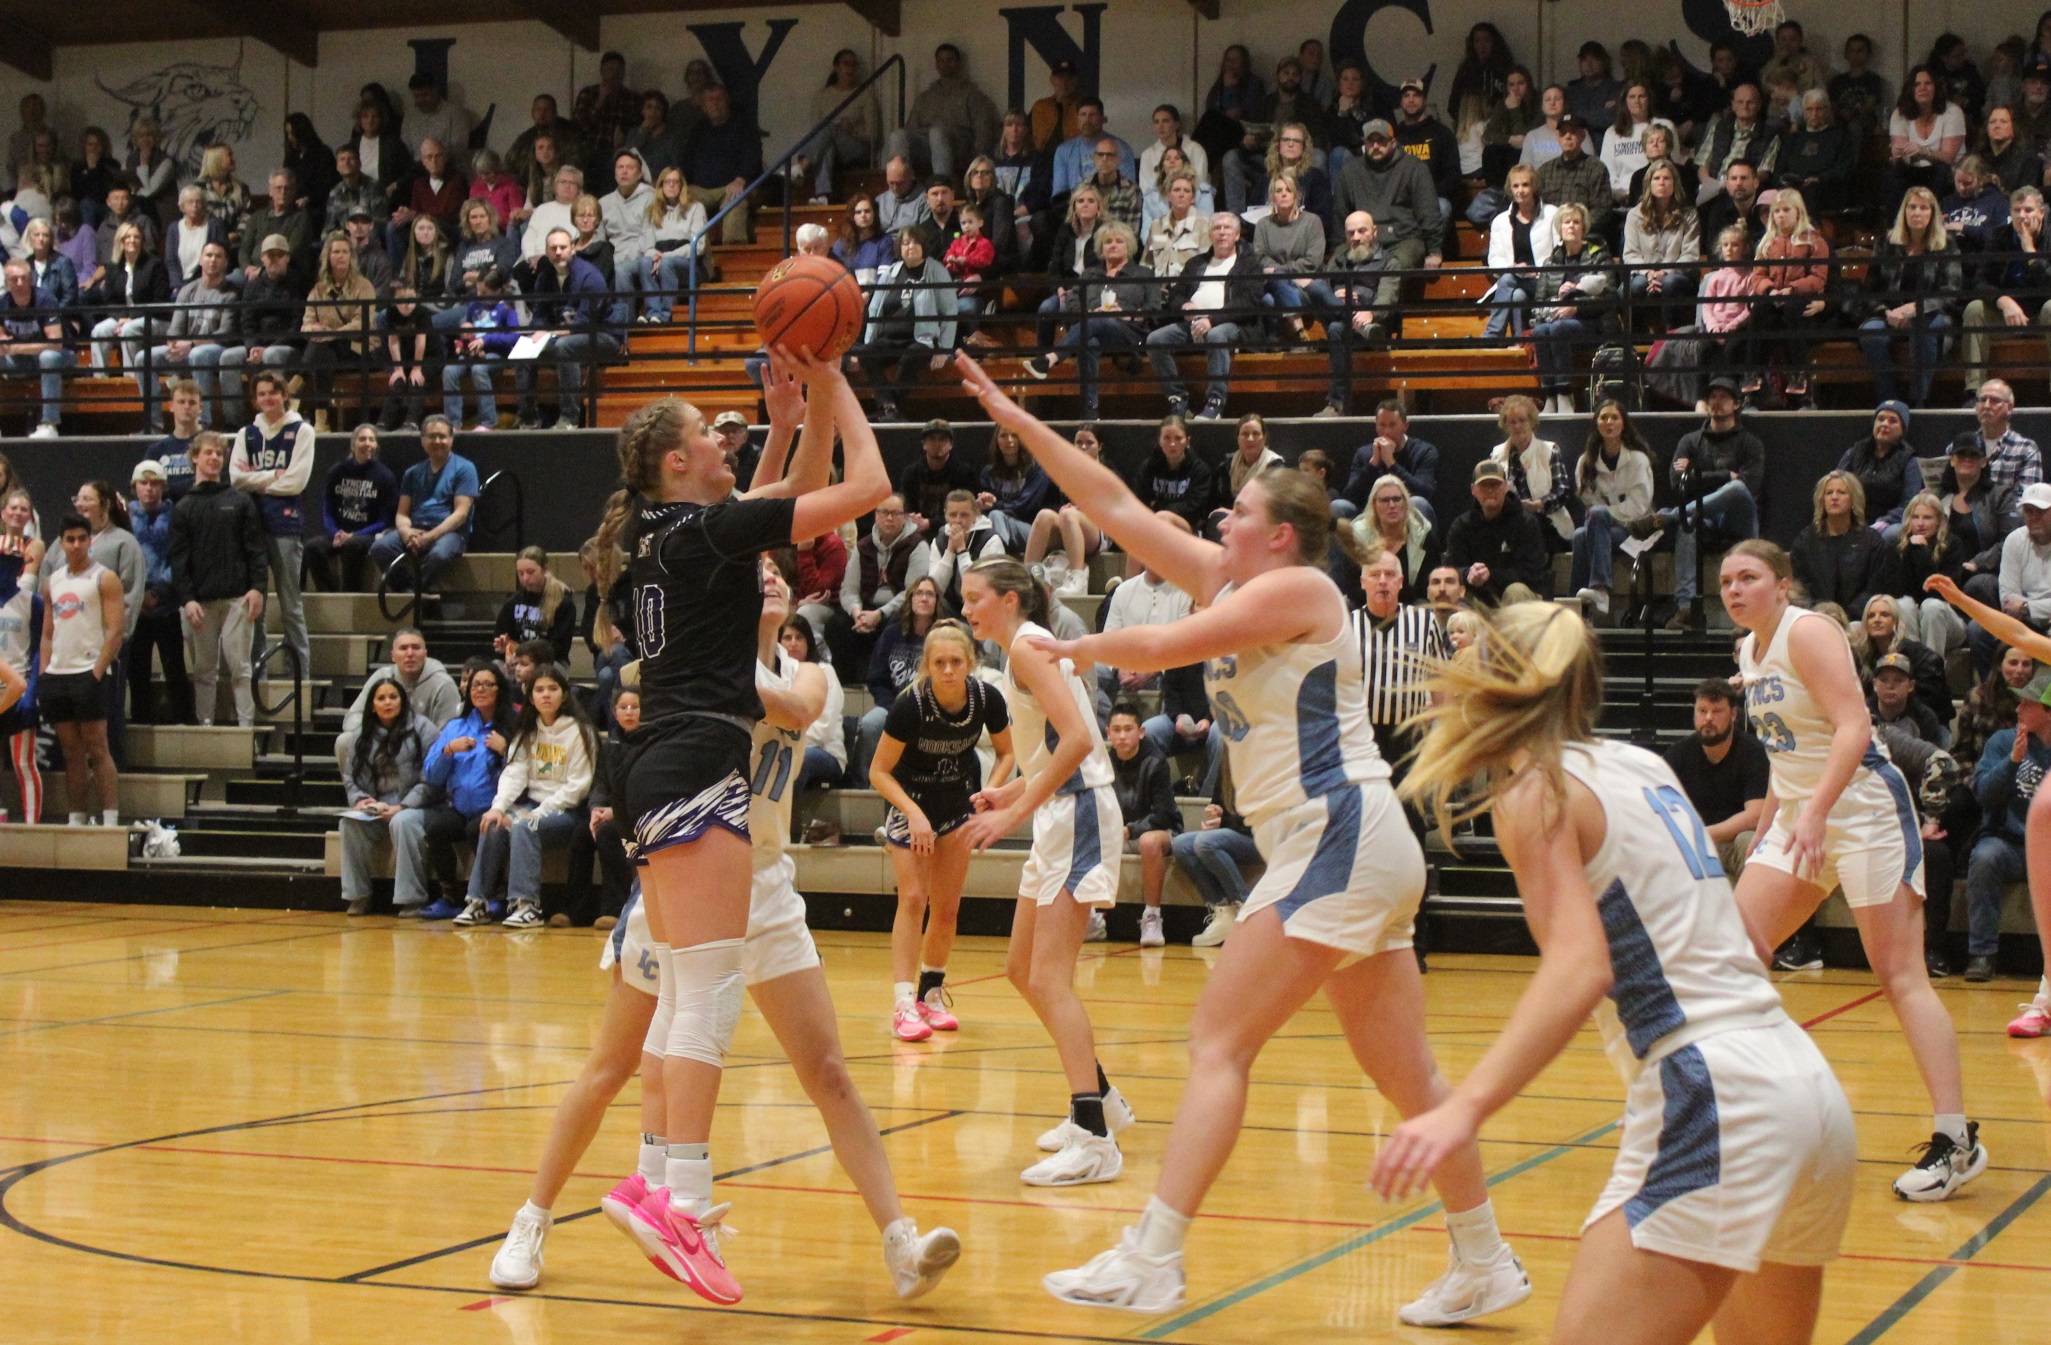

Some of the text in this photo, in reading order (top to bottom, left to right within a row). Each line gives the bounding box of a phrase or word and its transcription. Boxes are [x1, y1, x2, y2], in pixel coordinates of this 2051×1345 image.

[252, 450, 287, 470] USA
[752, 739, 792, 802] 11
[1641, 784, 1728, 881] 12
